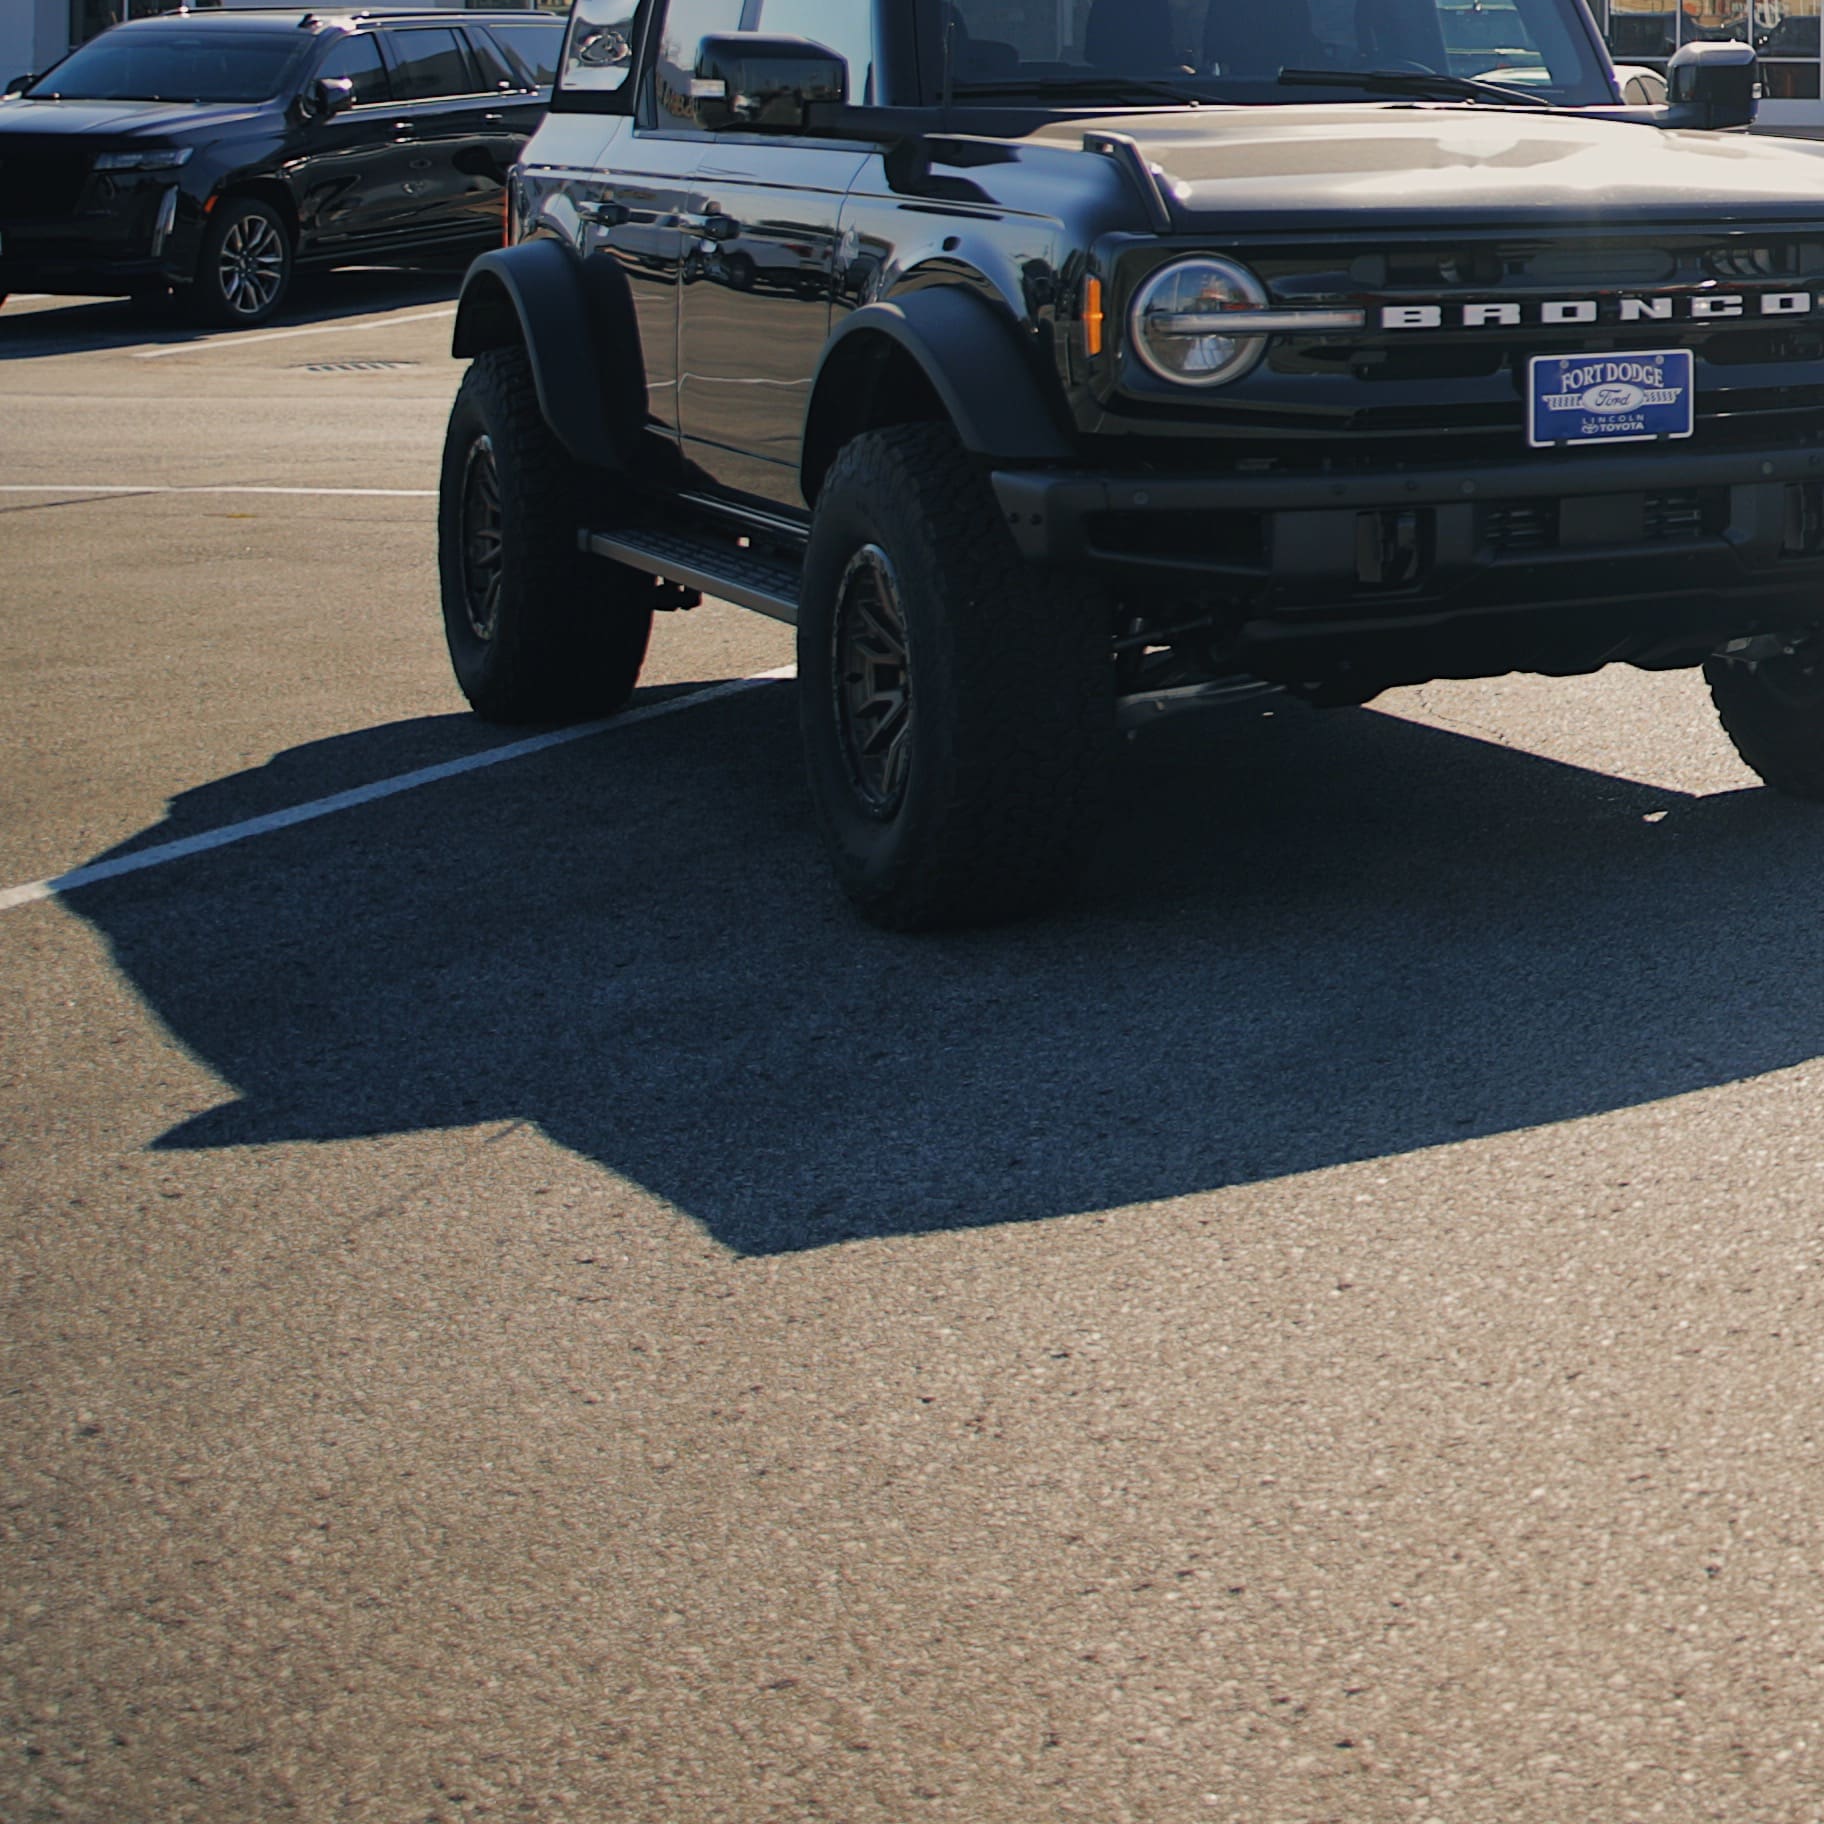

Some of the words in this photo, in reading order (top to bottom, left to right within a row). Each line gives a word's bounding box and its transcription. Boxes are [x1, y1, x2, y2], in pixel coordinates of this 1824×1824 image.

[1380, 291, 1811, 329] BRONCO
[1561, 363, 1605, 394] FORT
[1605, 362, 1665, 388] DODGE
[1594, 388, 1632, 407] Ford
[1582, 414, 1645, 425] LINCOLN
[1600, 422, 1645, 432] TOYOTA
